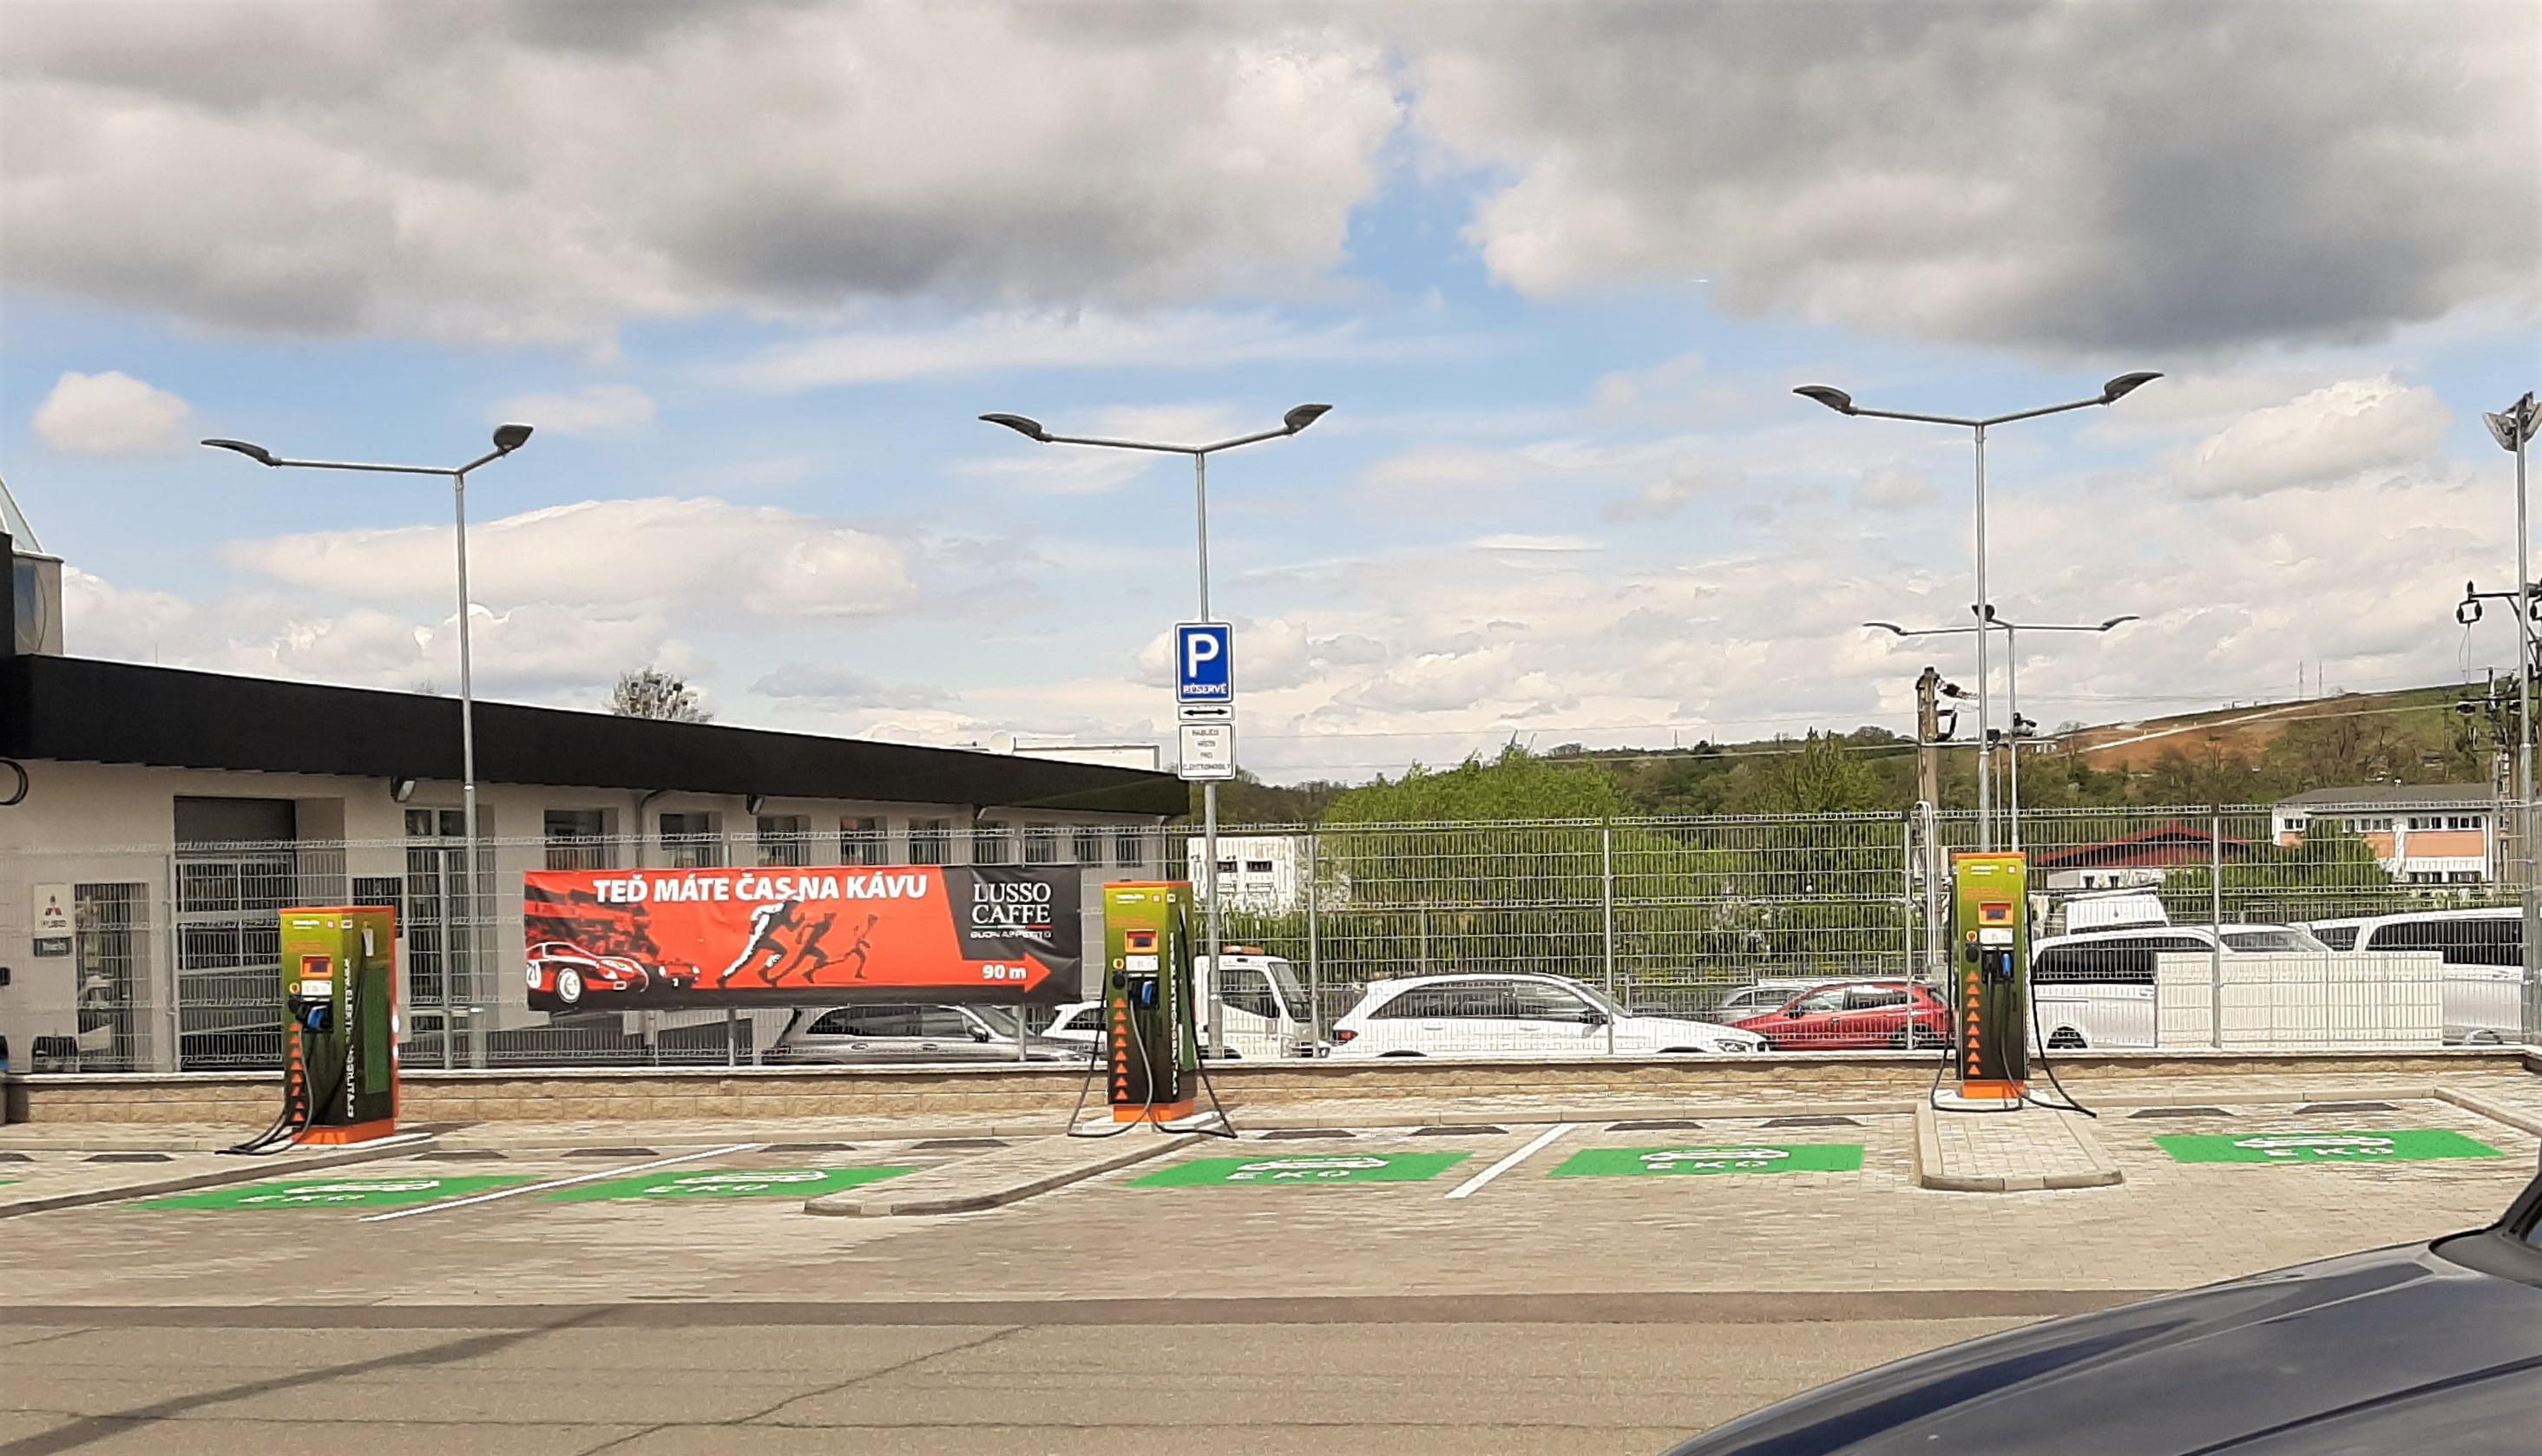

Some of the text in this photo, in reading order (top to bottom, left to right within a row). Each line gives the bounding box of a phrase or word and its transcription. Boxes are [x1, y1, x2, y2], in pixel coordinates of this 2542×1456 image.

[1187, 633, 1219, 679] P
[593, 870, 928, 903] TEĎ MÁTE ČAS NA KÁVU
[974, 882, 1052, 902] LUSSO
[972, 904, 1052, 924] CAFFE
[982, 964, 1027, 980] 90 m
